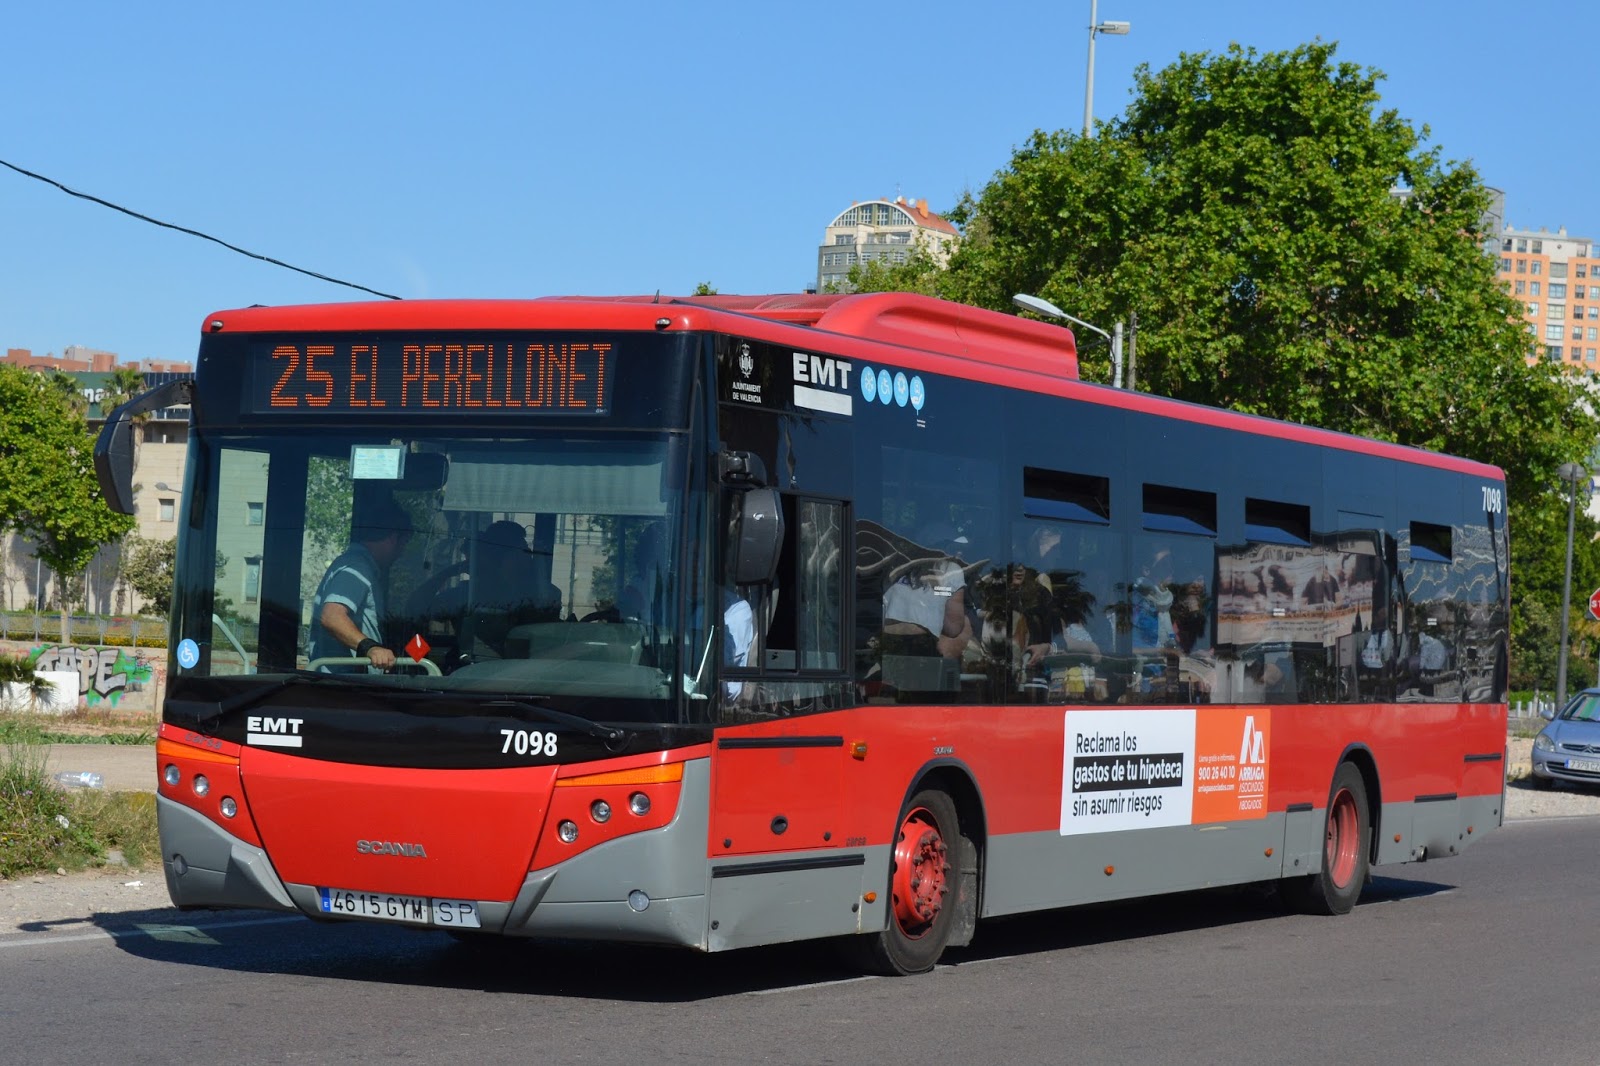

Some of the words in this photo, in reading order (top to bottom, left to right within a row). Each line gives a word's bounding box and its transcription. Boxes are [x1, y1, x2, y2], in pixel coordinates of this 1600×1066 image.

[271, 346, 334, 406] 25
[350, 345, 386, 406] EL
[401, 344, 611, 407] PERELLONET
[793, 352, 852, 389] EMT
[732, 381, 761, 392] AJUNTAMENT
[732, 392, 740, 400] DE
[740, 393, 761, 403] VALENCIA
[1481, 486, 1501, 513] 7098
[247, 716, 303, 733] EMT
[500, 729, 558, 757] 7098
[1076, 731, 1120, 753] Reclama
[1122, 731, 1137, 752] los
[1074, 762, 1109, 789] gastos
[1111, 760, 1125, 781] de
[1127, 760, 1138, 780] tu
[1140, 758, 1181, 785] hipoteca
[1198, 767, 1211, 780] 900
[1211, 766, 1219, 779] 26
[1220, 766, 1228, 779] 40
[1228, 765, 1235, 778] 10
[1239, 766, 1264, 781] ARRIAGA
[1239, 782, 1264, 792] ASOCIADOS
[1073, 794, 1088, 816] sin
[1090, 792, 1125, 815] asumir
[1127, 791, 1162, 816] riesgos
[1239, 799, 1262, 810] ABOGADOS
[357, 840, 427, 858] SCANIA
[334, 891, 381, 914] 4615
[387, 897, 422, 919] GYM
